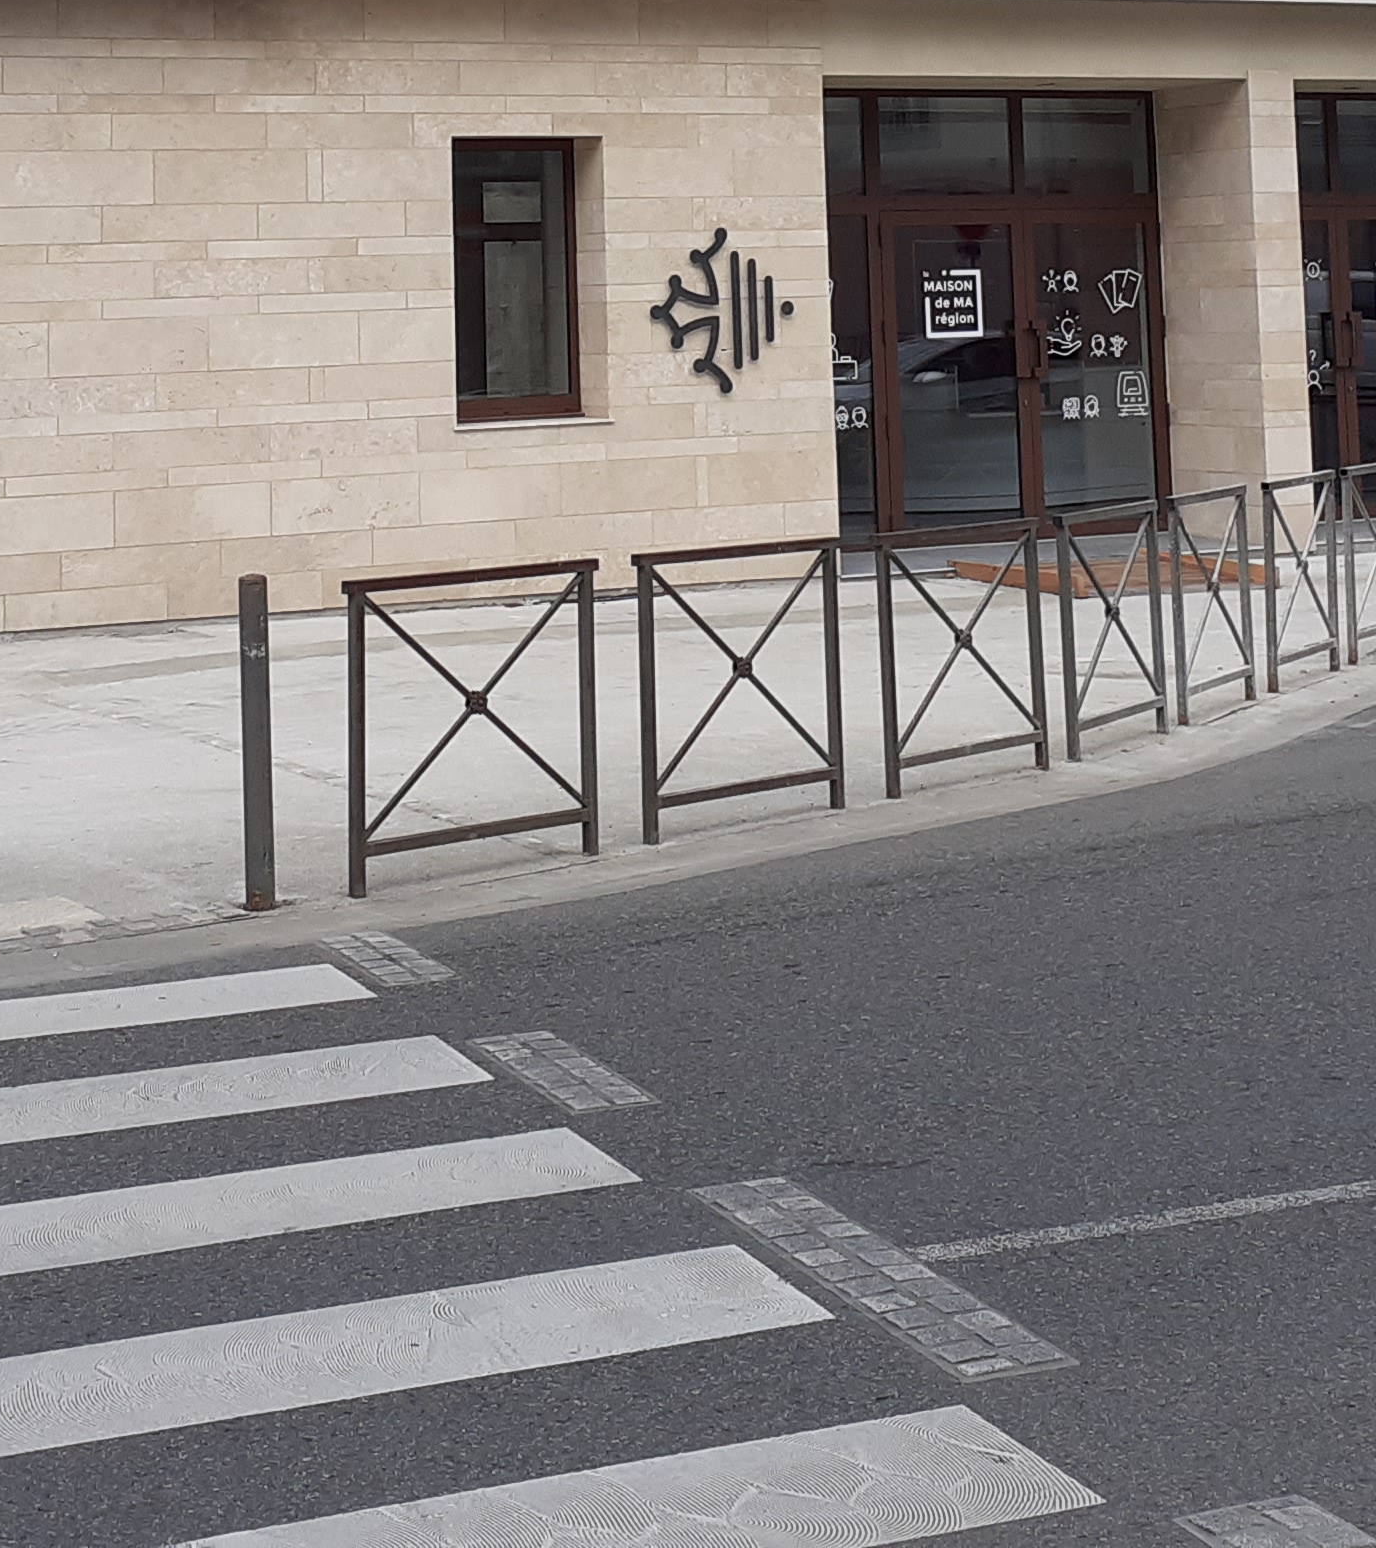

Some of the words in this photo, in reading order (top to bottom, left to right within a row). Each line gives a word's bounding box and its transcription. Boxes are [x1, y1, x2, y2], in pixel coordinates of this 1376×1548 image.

[923, 279, 973, 292] MAISON
[934, 296, 951, 309] de
[953, 296, 974, 309] MA
[935, 312, 975, 327] région
